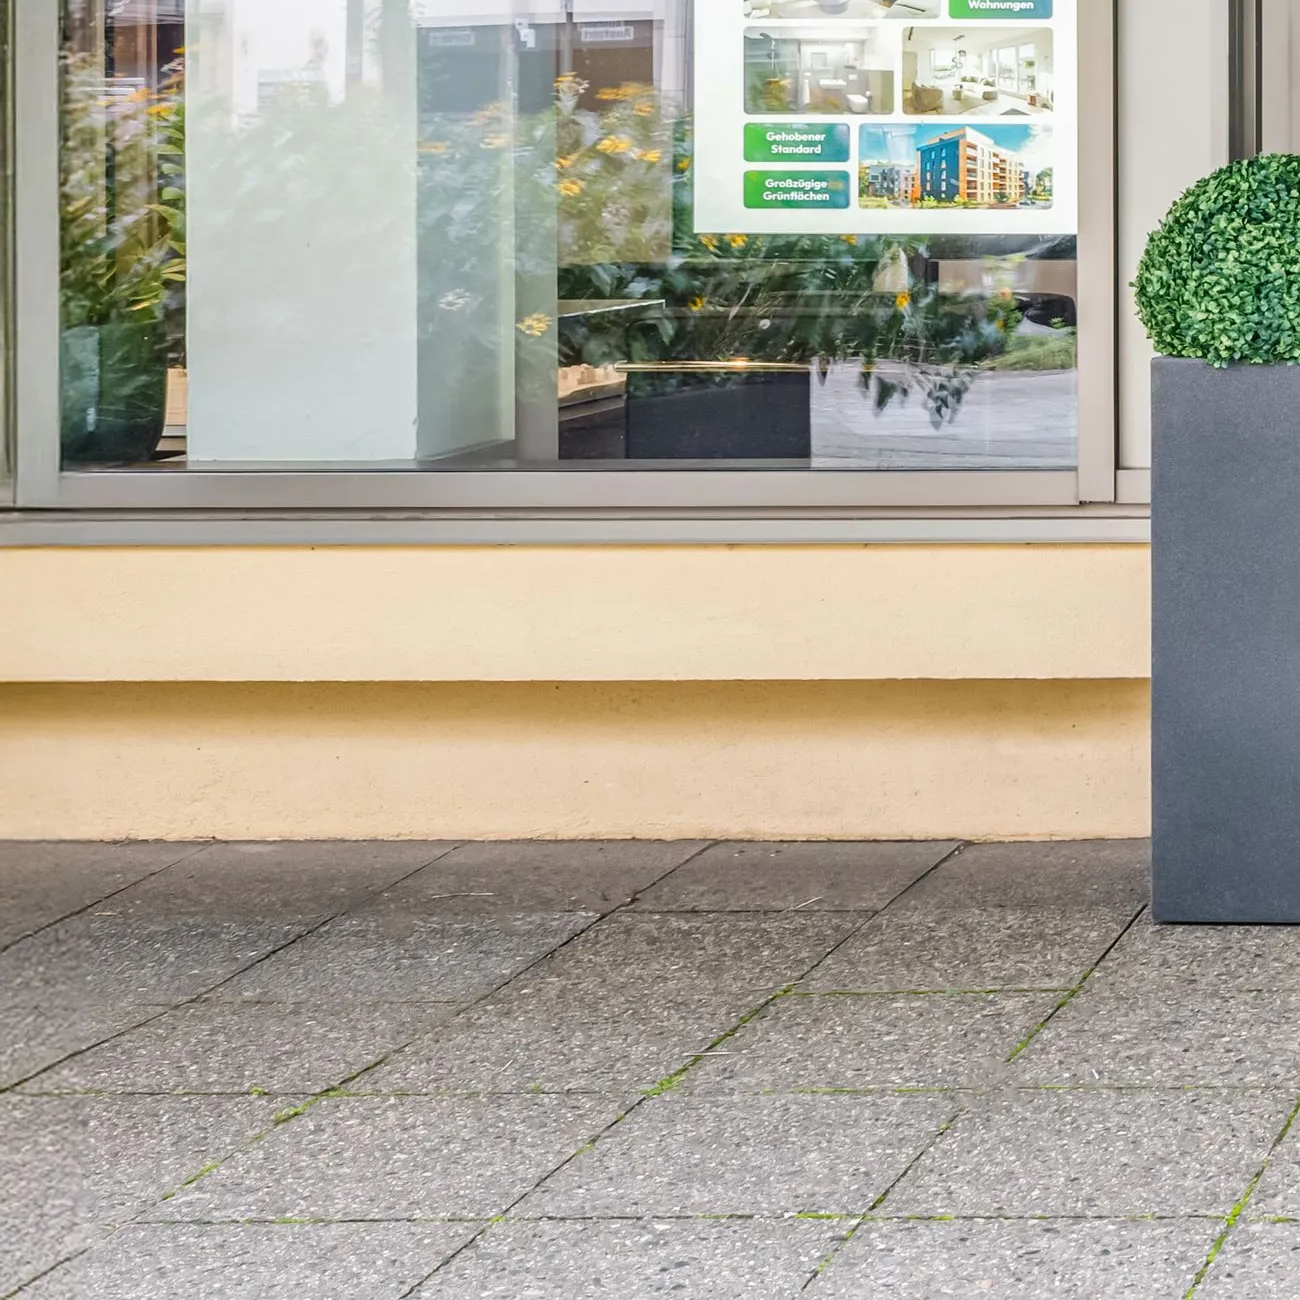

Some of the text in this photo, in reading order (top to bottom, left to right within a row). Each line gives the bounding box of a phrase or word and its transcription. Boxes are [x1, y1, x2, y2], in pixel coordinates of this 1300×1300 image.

[968, 0, 1034, 11] Wohnungen
[766, 132, 826, 141] Gehobener
[771, 144, 821, 154] Standard
[765, 178, 828, 190] Großzügige
[763, 191, 829, 201] Grünflächen
